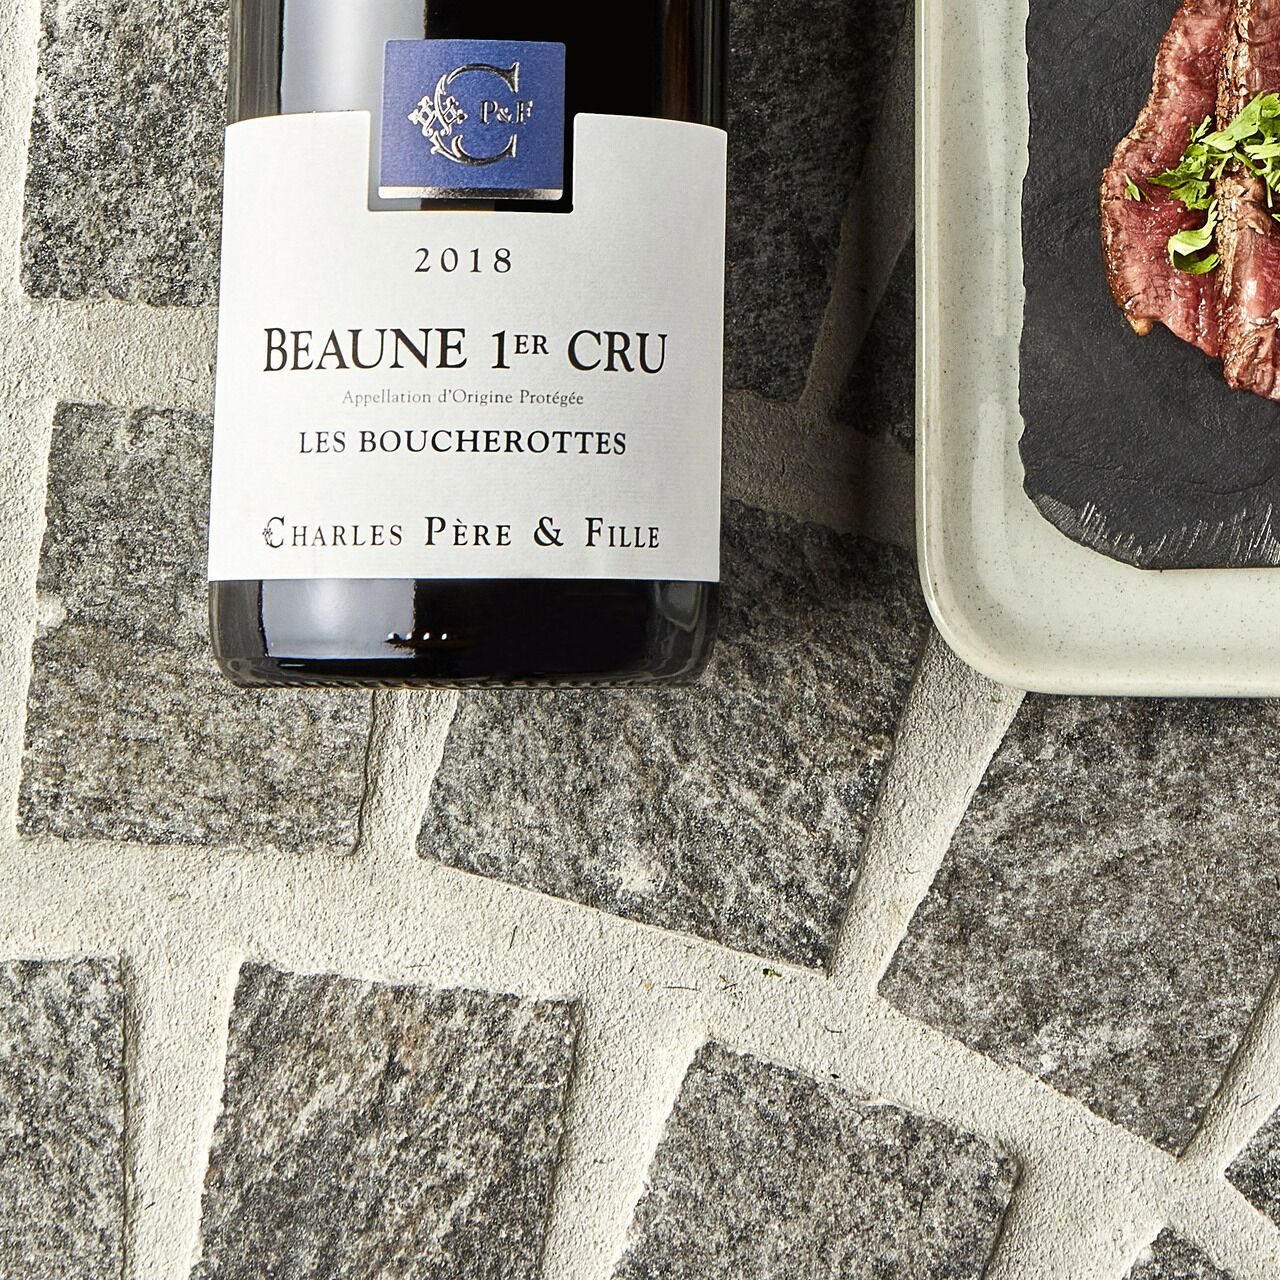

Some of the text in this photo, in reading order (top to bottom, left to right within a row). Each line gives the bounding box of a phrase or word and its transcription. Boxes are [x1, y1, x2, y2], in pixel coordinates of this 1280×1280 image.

[479, 99, 534, 126] P&F
[414, 247, 513, 273] 2018
[263, 327, 668, 374] BEAUNE 1ER CRU
[342, 388, 584, 407] Appellation d'Origine Protégée
[299, 429, 627, 456] LES BOUCHEROTTES
[262, 515, 660, 549] CHARLES PÈRE & FILLE
